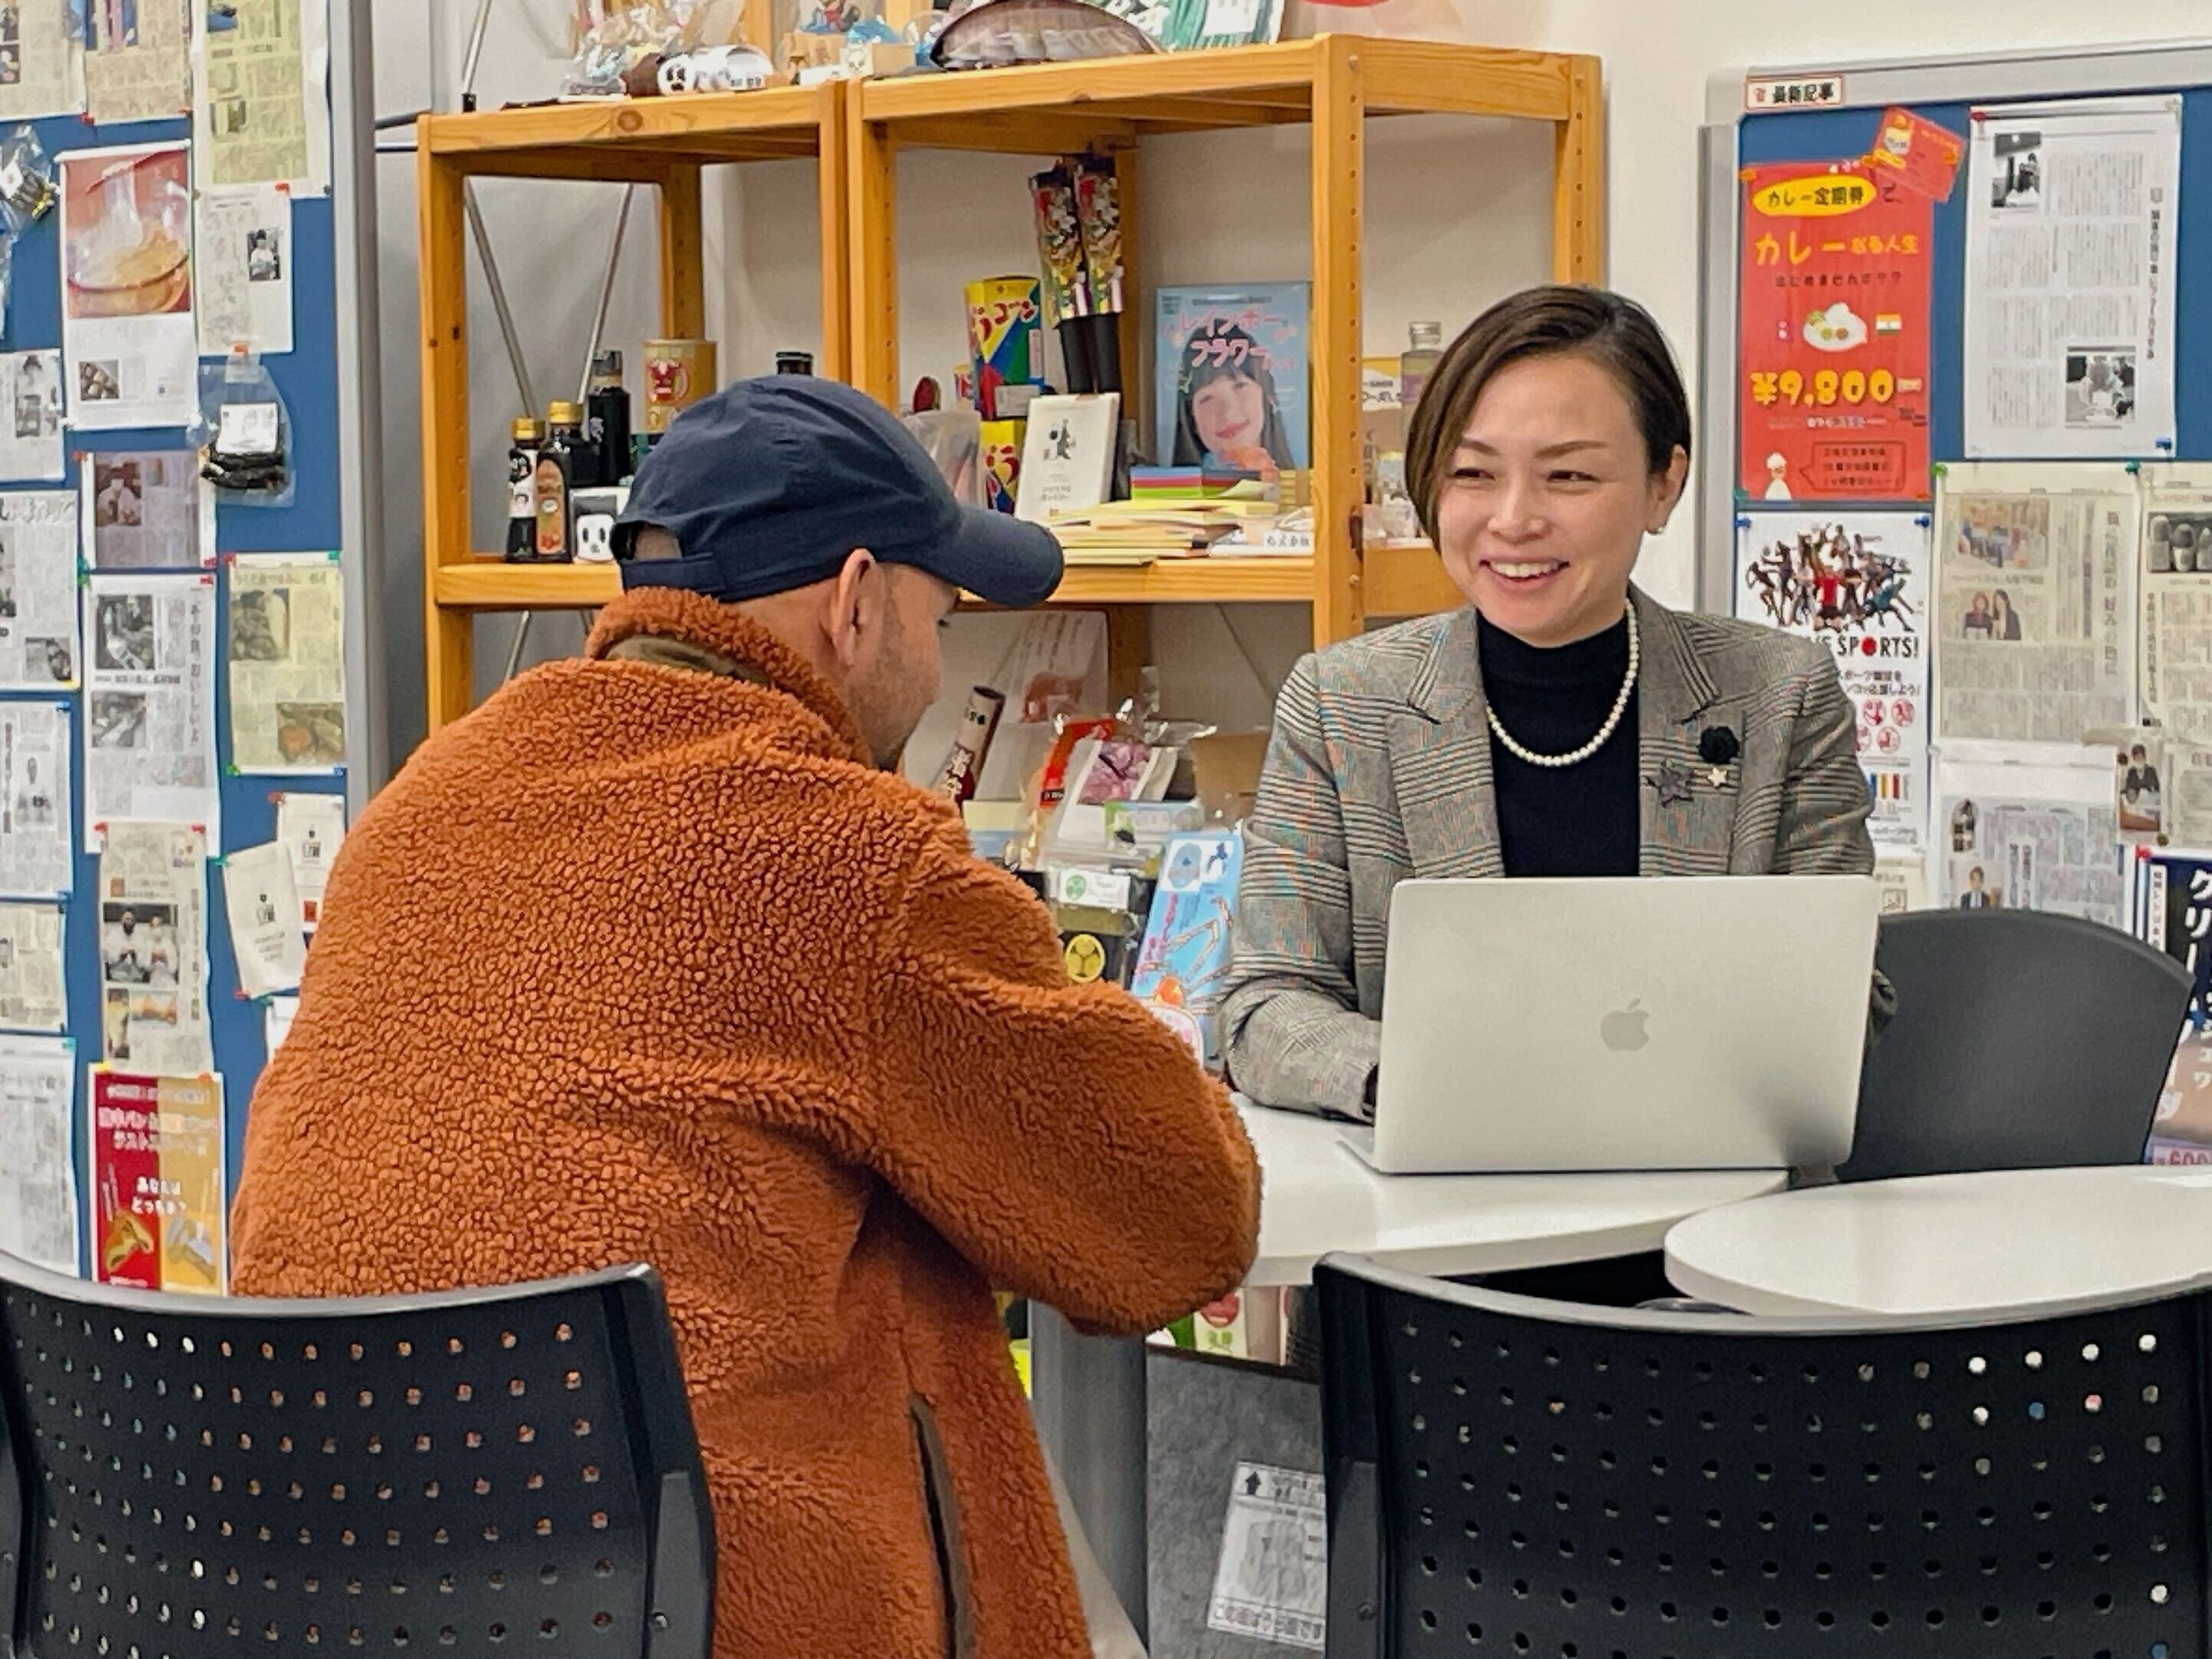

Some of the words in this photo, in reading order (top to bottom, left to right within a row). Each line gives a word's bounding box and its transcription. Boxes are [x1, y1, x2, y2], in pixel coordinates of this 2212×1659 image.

[1773, 81, 1834, 103] 最新記事
[1750, 369, 1894, 408] ¥9,800
[1838, 635, 1919, 657] SPORTS!
